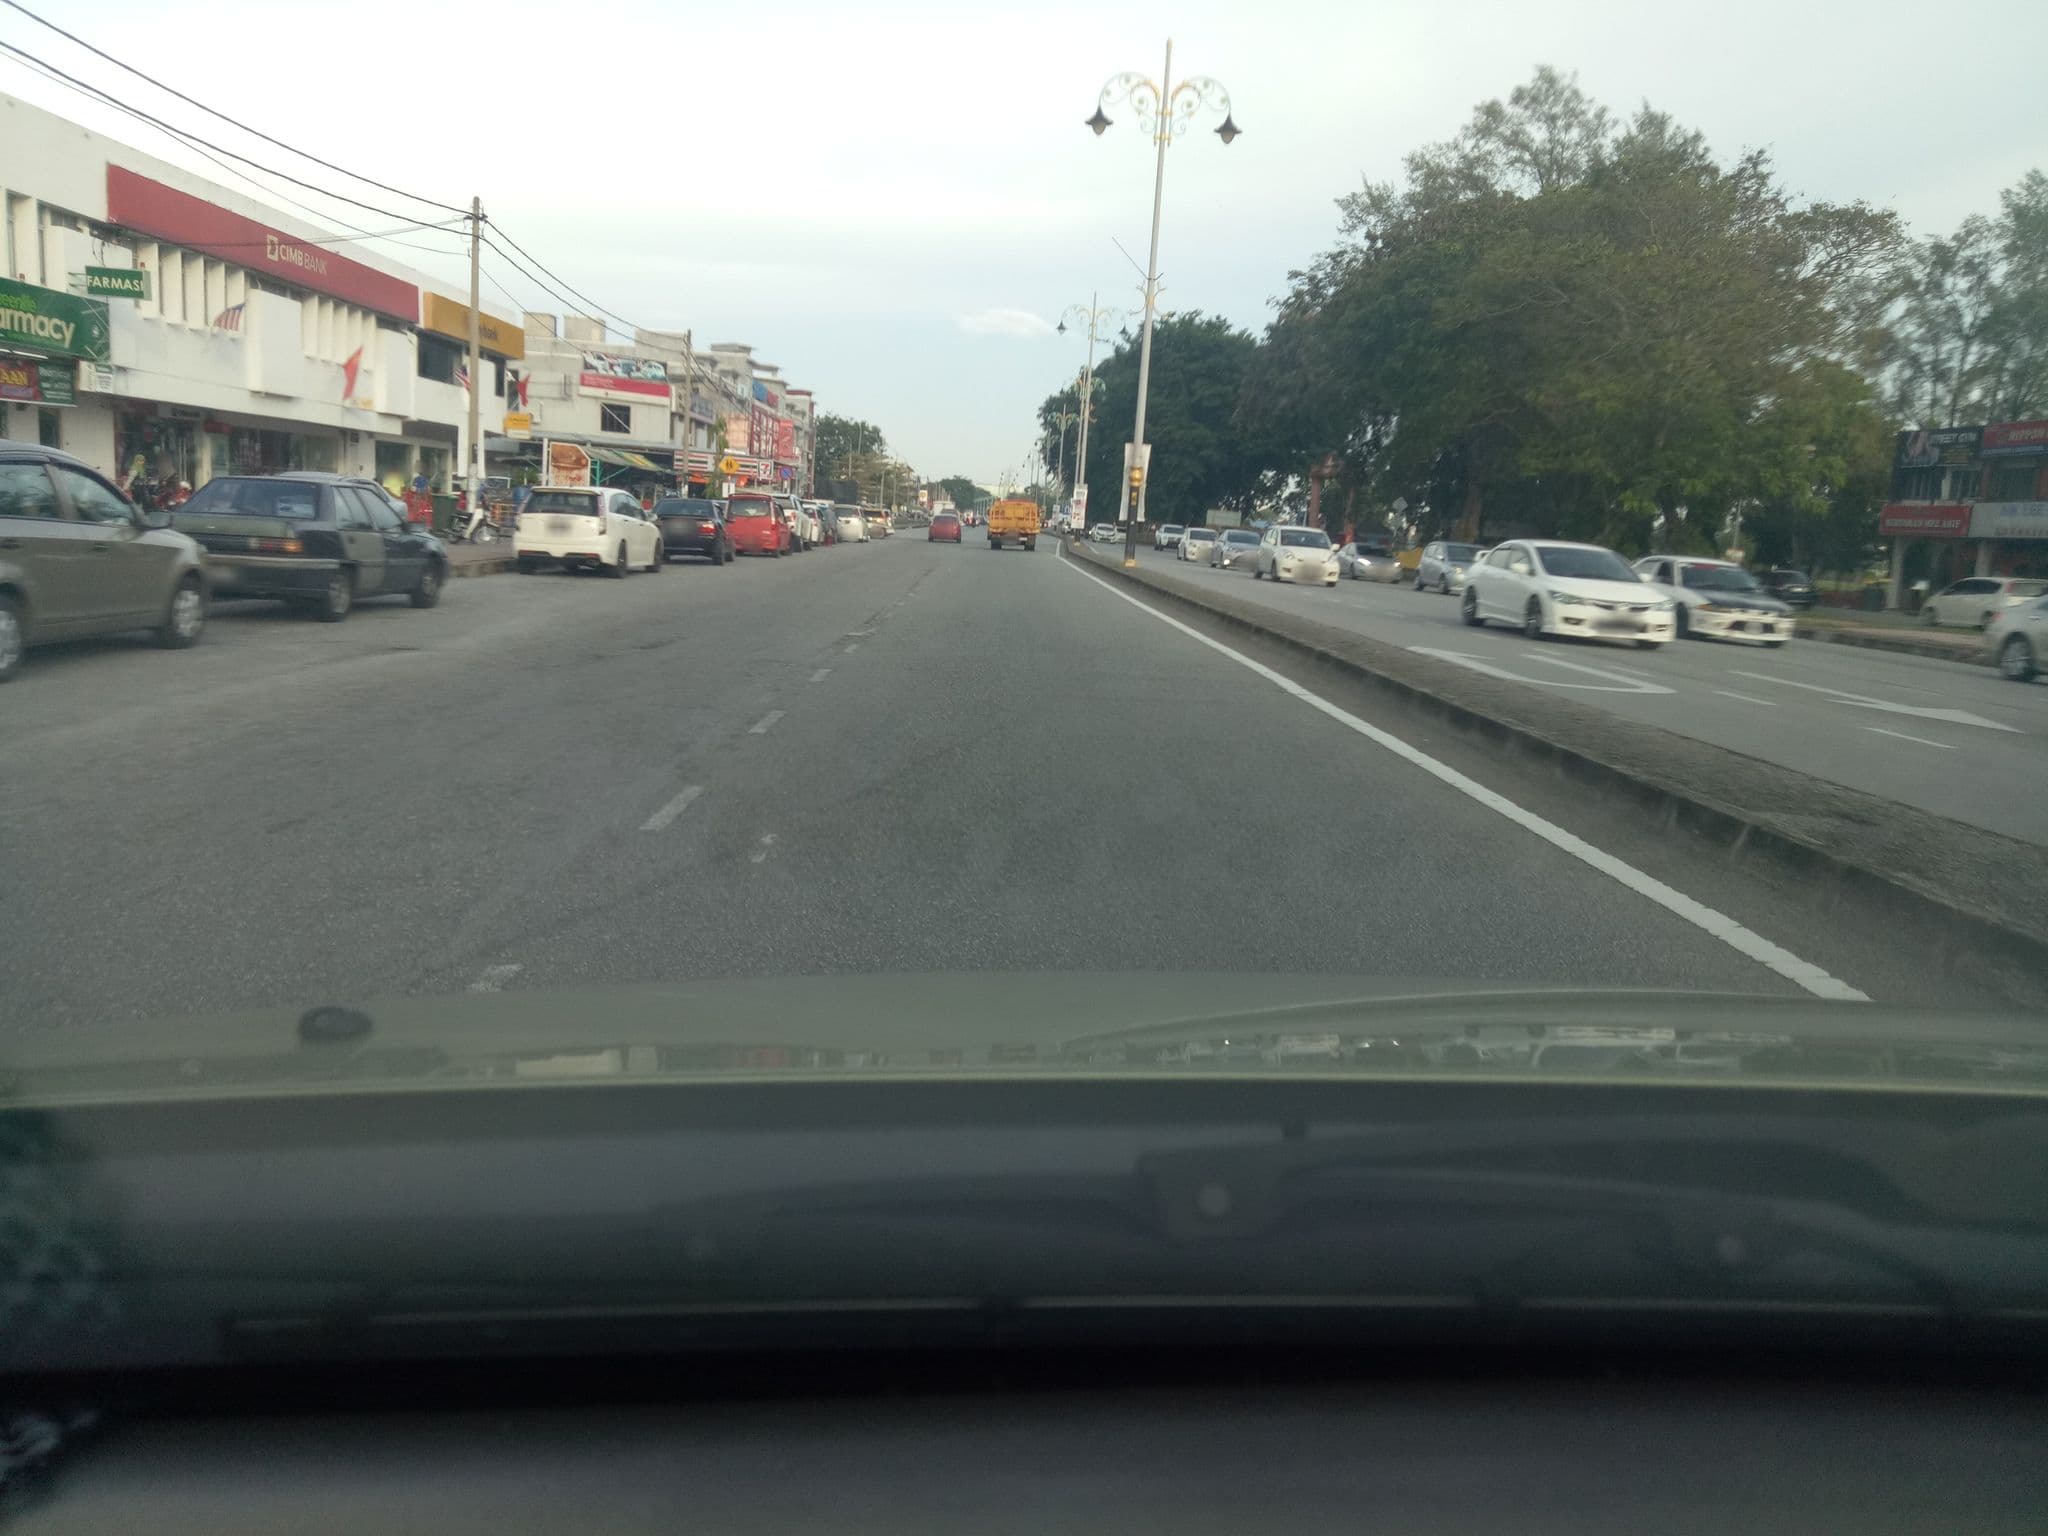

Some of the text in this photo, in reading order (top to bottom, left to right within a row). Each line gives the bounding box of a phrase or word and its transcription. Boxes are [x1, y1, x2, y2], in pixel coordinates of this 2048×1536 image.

[279, 244, 328, 277] CIMB BANK
[87, 276, 144, 292] FARMASI
